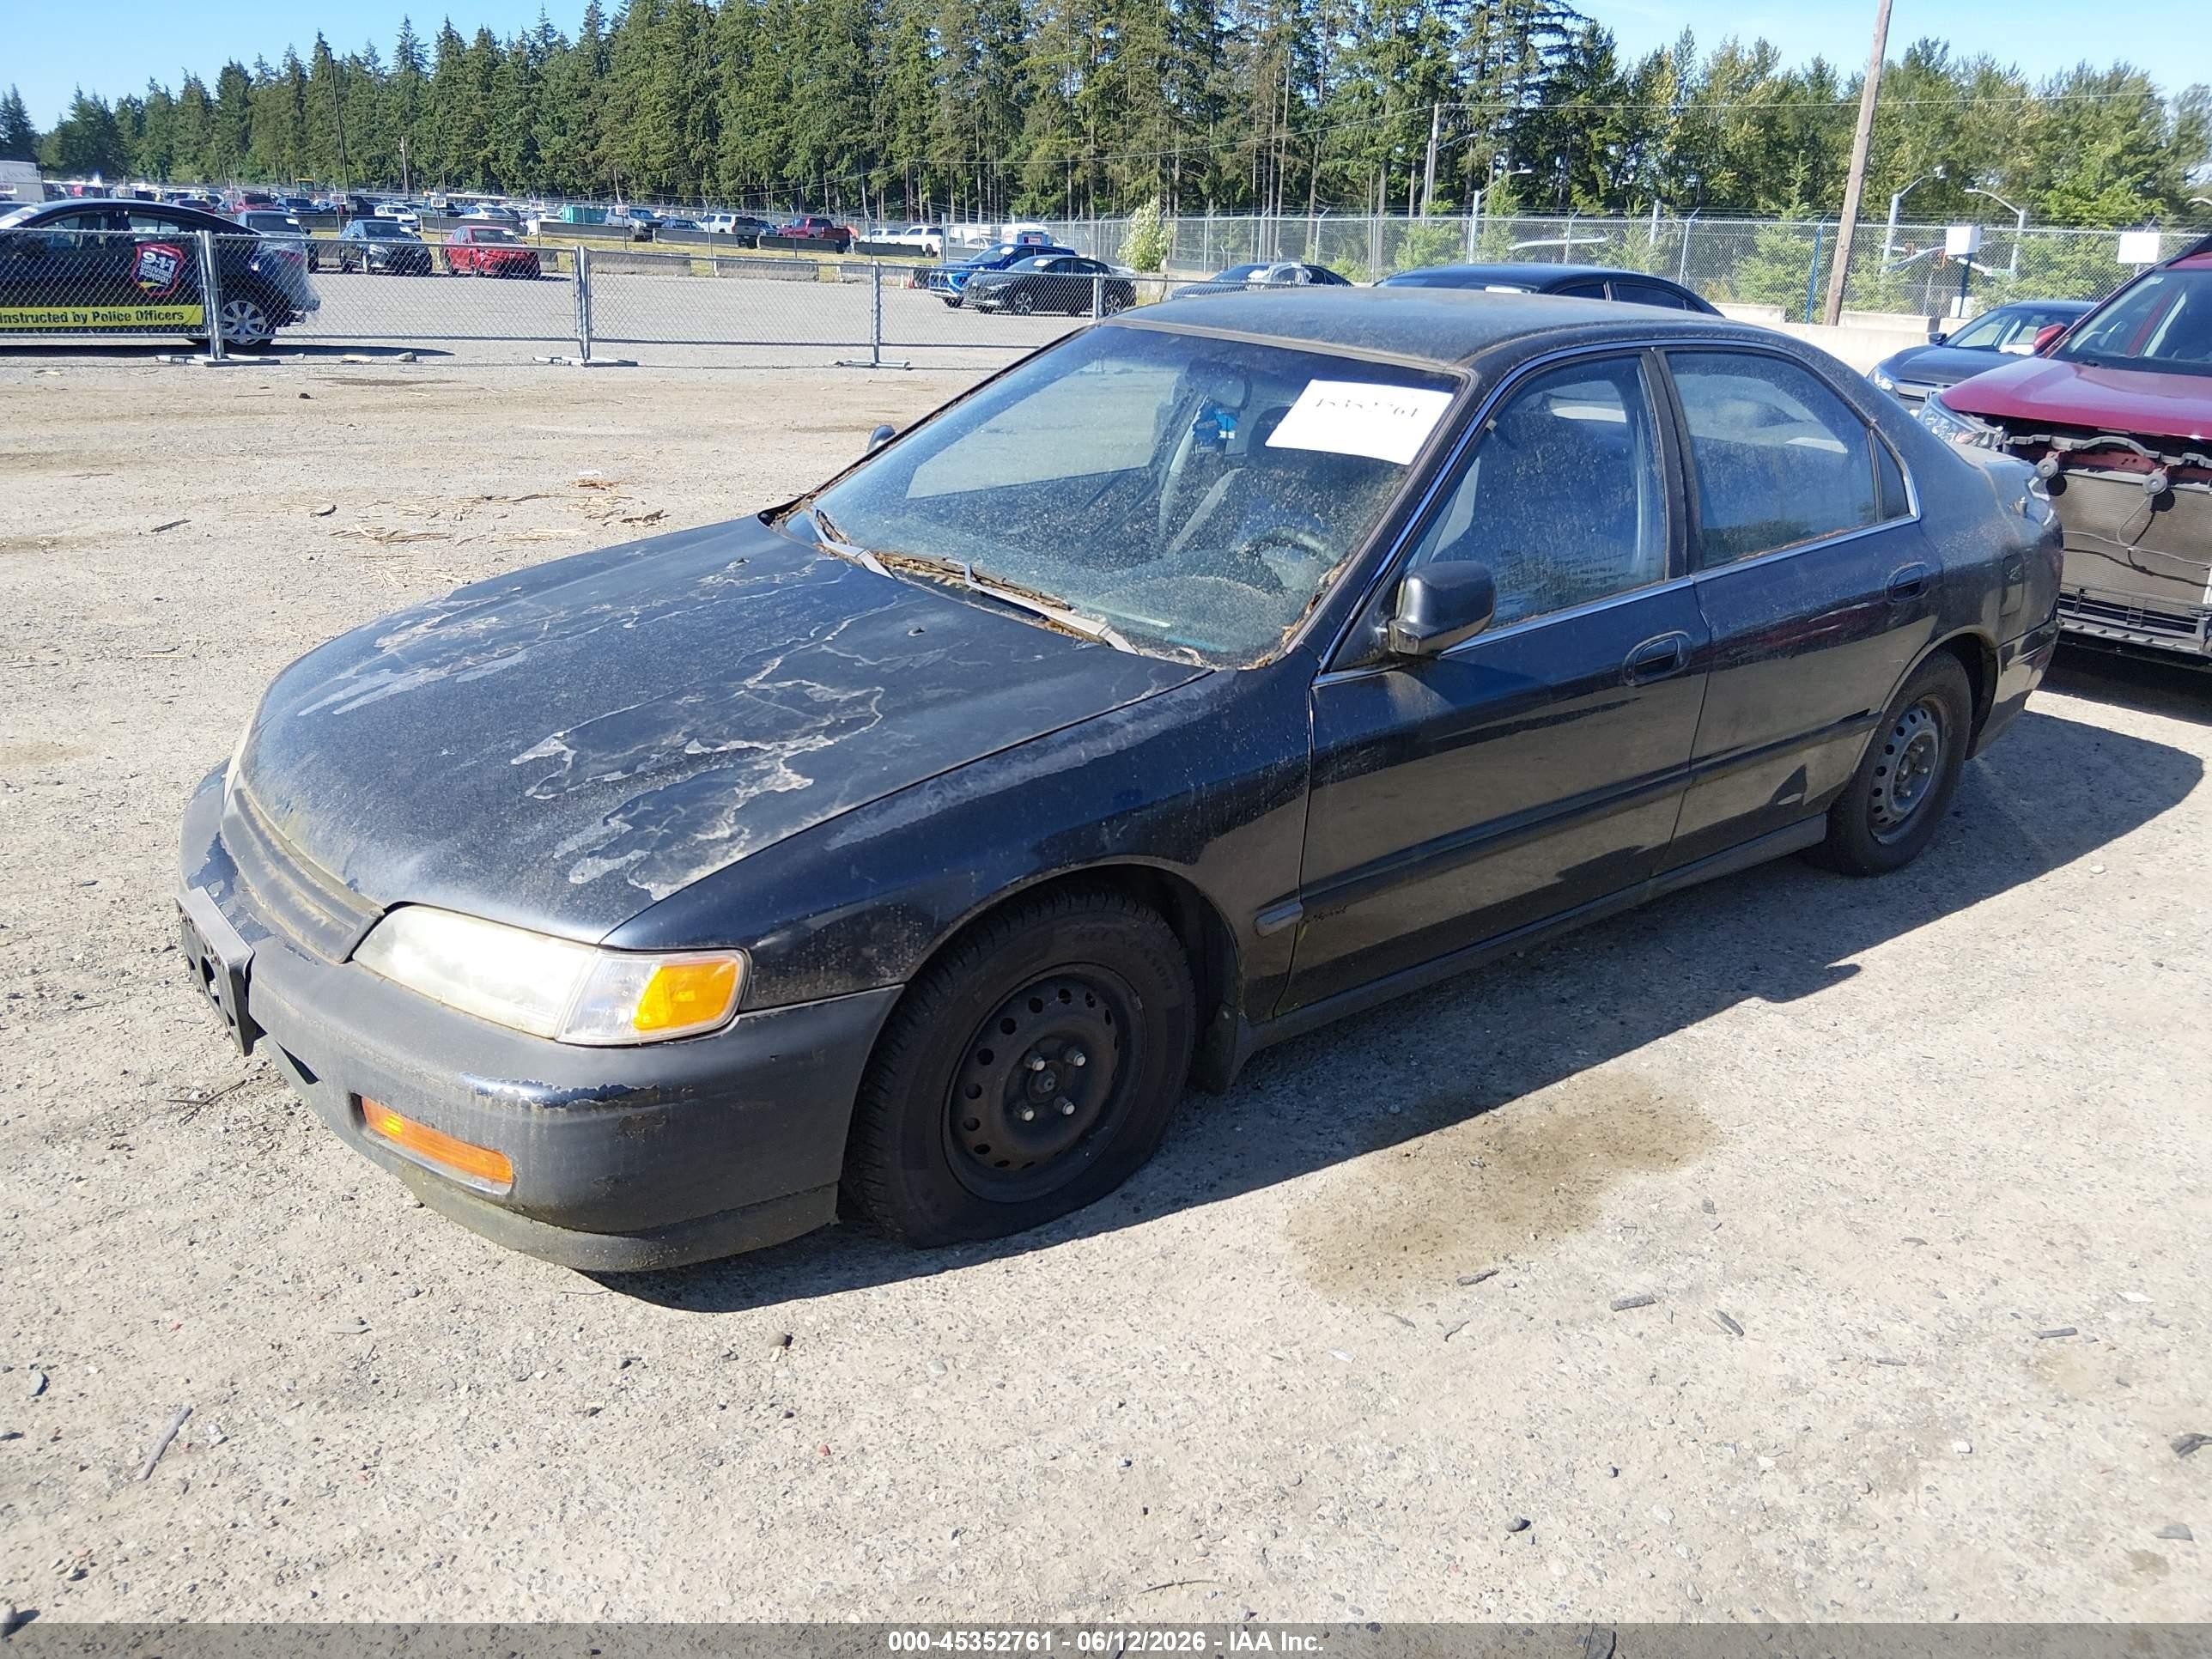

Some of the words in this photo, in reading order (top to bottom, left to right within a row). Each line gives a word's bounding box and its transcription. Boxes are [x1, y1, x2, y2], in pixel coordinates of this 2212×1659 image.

[138, 268, 172, 284] SCHOOL
[140, 261, 173, 278] DRIVING
[73, 311, 88, 325] by
[92, 310, 131, 322] Police
[136, 309, 185, 322] Officers
